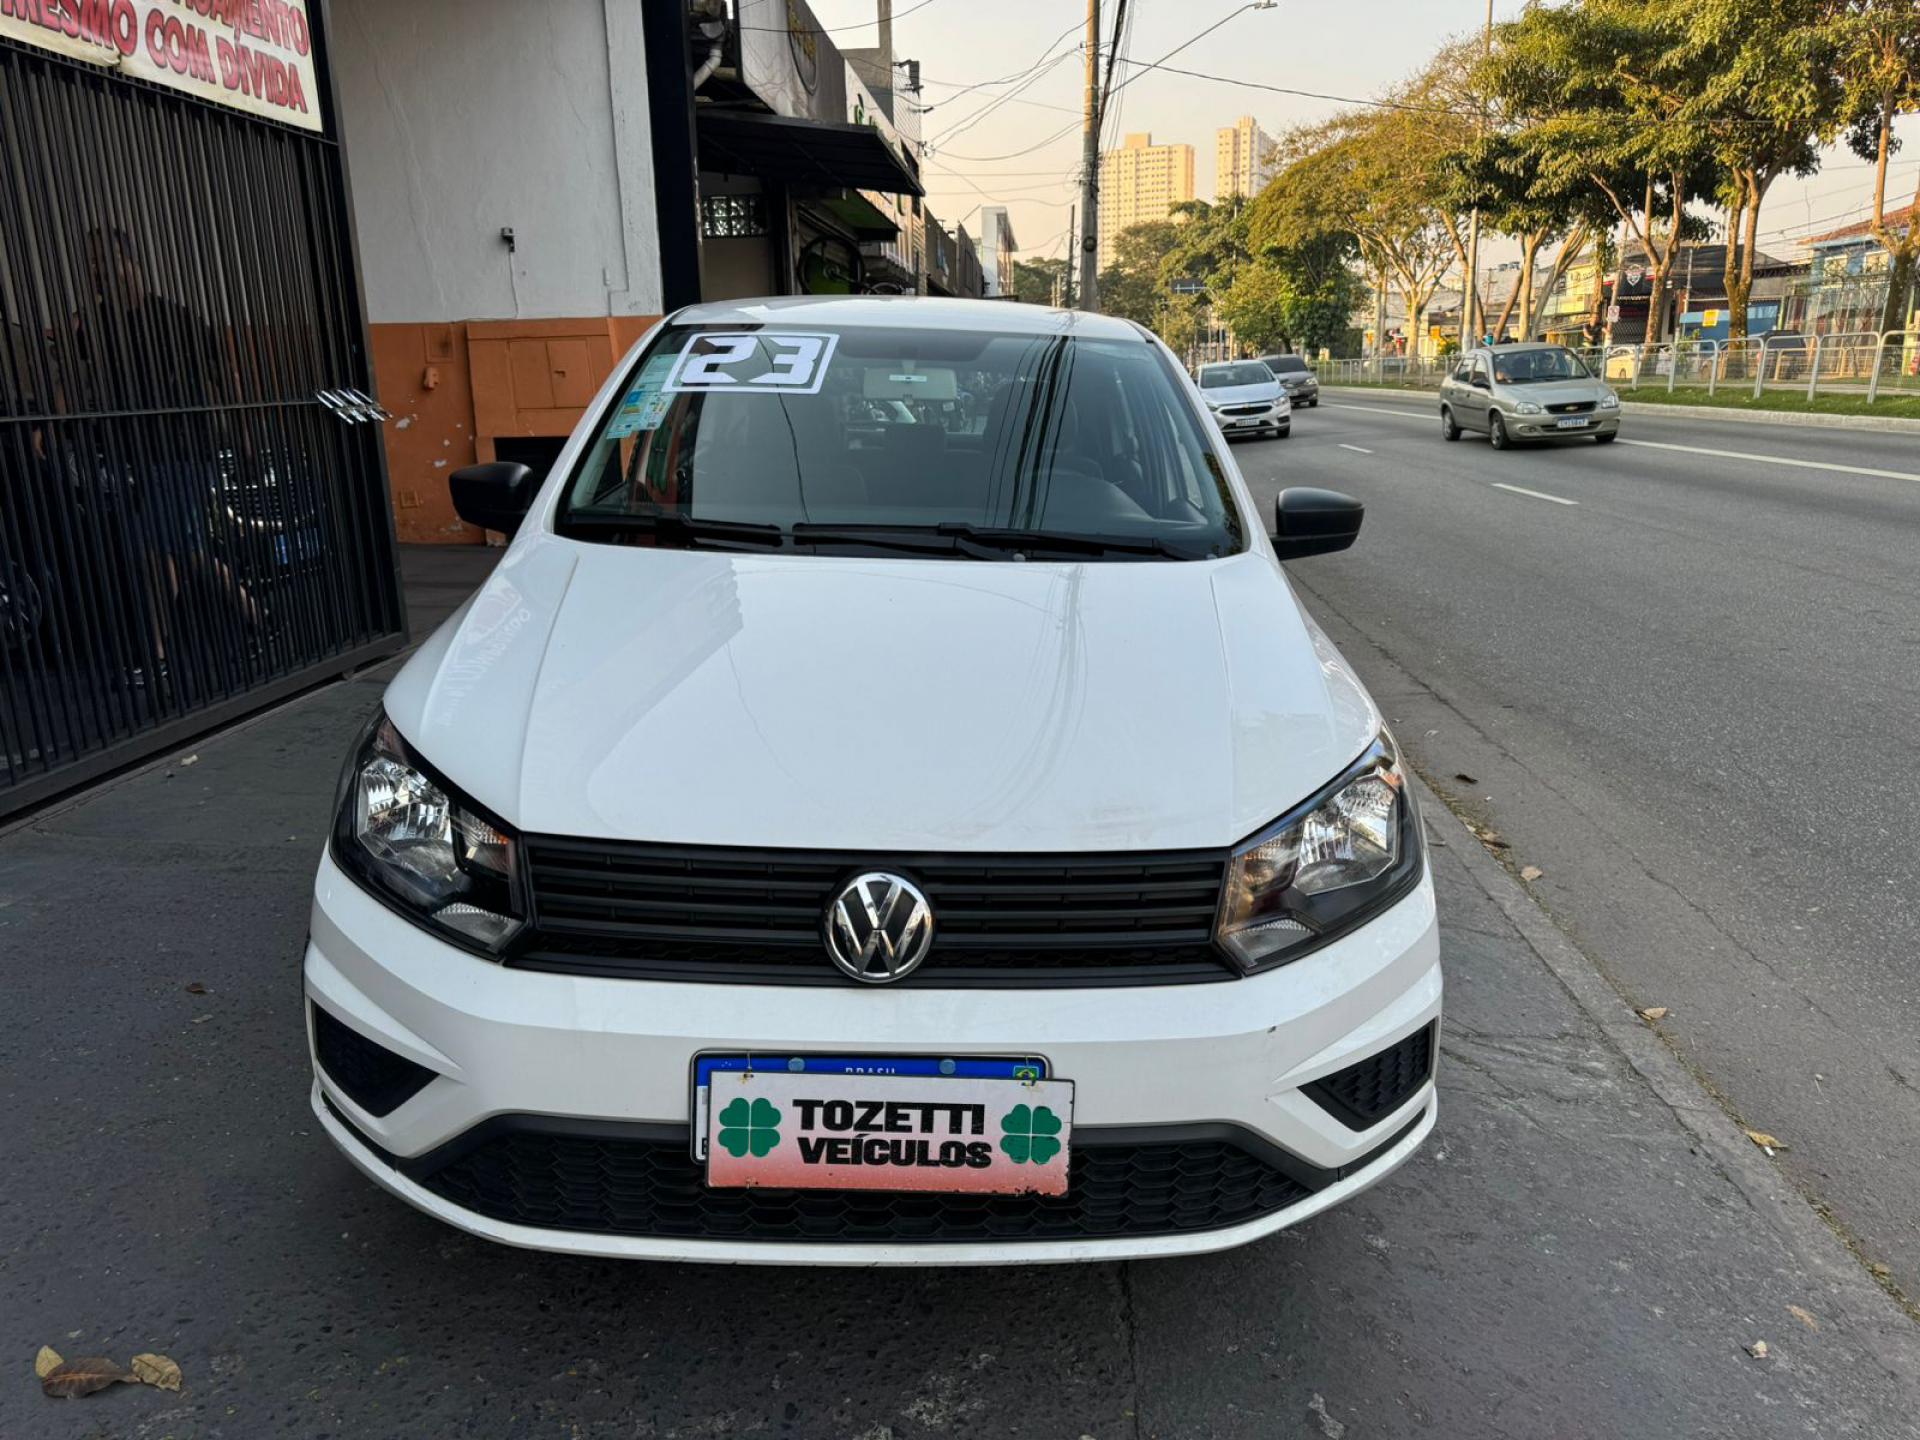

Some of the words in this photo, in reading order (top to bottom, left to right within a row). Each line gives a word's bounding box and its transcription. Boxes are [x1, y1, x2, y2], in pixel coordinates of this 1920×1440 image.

[145, 8, 216, 84] COM
[216, 22, 308, 114] DÍVIDA
[679, 336, 823, 385] 23
[834, 875, 926, 976] VW
[792, 1098, 985, 1135] TOZETTI
[797, 1133, 992, 1169] VEÍCULOS
